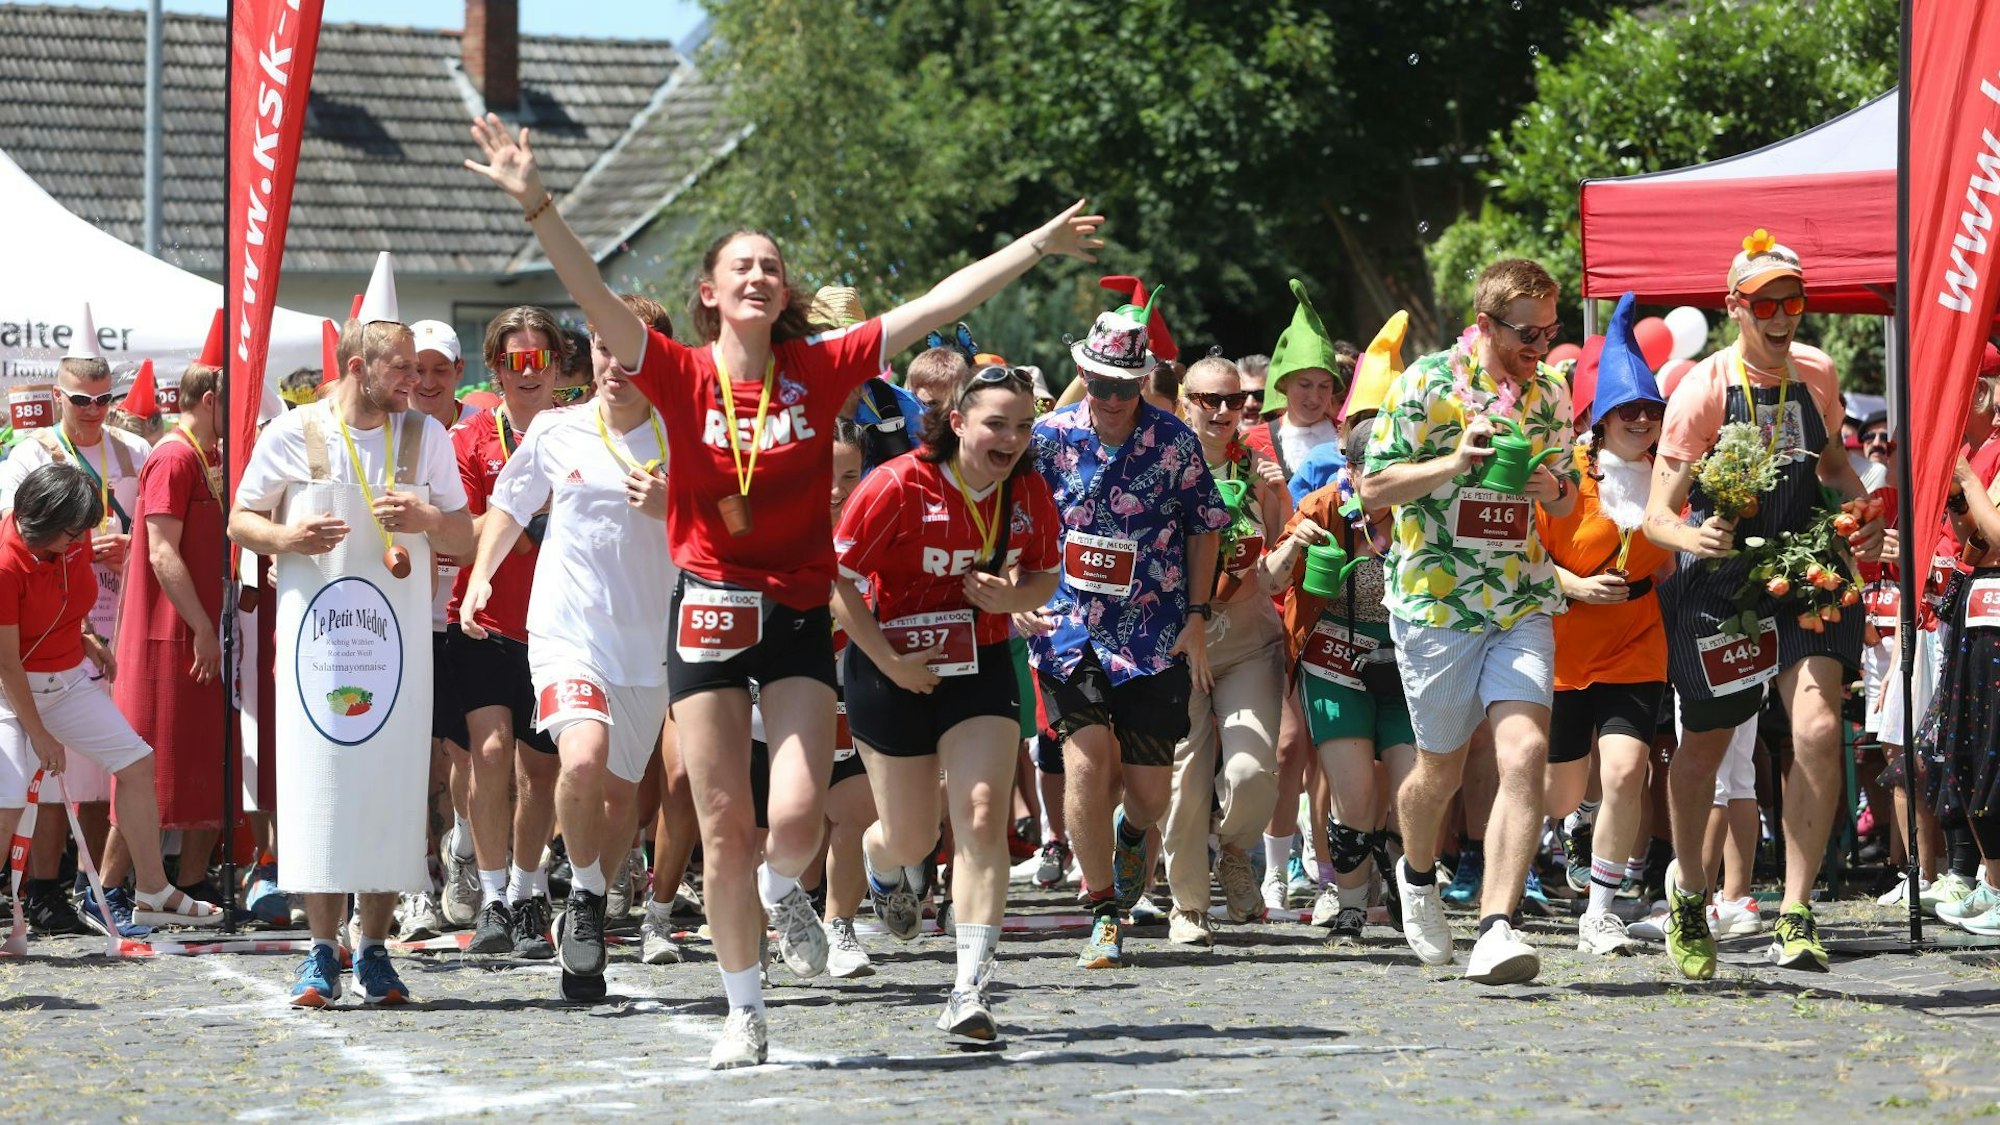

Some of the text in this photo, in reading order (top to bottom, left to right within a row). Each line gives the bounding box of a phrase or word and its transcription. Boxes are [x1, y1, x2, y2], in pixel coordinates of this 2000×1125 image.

[1, 319, 133, 350] alteer
[15, 404, 43, 418] 388
[702, 404, 816, 452] REWE
[1479, 506, 1515, 523] 416
[1483, 528, 1508, 537] Henning
[923, 546, 1023, 577] REE
[1080, 550, 1116, 569] 485
[313, 608, 387, 641] Le Petit Médoc
[691, 609, 734, 630] 593
[326, 639, 349, 647] Richtig
[906, 628, 949, 648] 337
[1321, 640, 1355, 662] 358
[1722, 643, 1761, 664] 446
[312, 661, 387, 673] Salatmayonnaise
